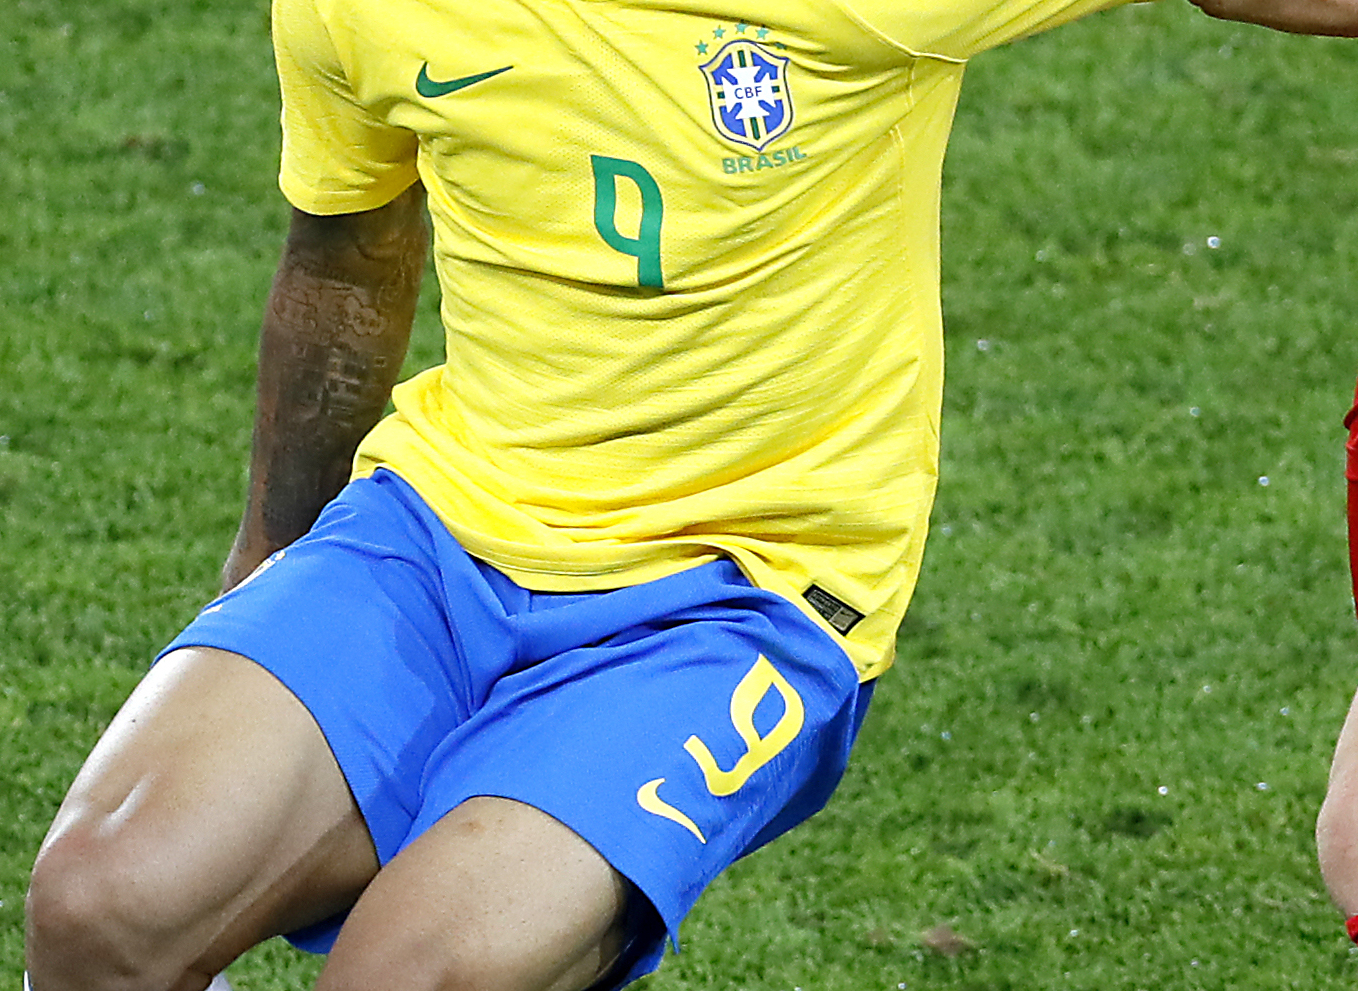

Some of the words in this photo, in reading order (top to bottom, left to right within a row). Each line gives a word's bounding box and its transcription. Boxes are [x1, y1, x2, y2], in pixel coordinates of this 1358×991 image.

[734, 86, 762, 99] CBF
[722, 146, 807, 175] BRASIL
[590, 154, 664, 289] 9
[683, 653, 805, 797] 9
